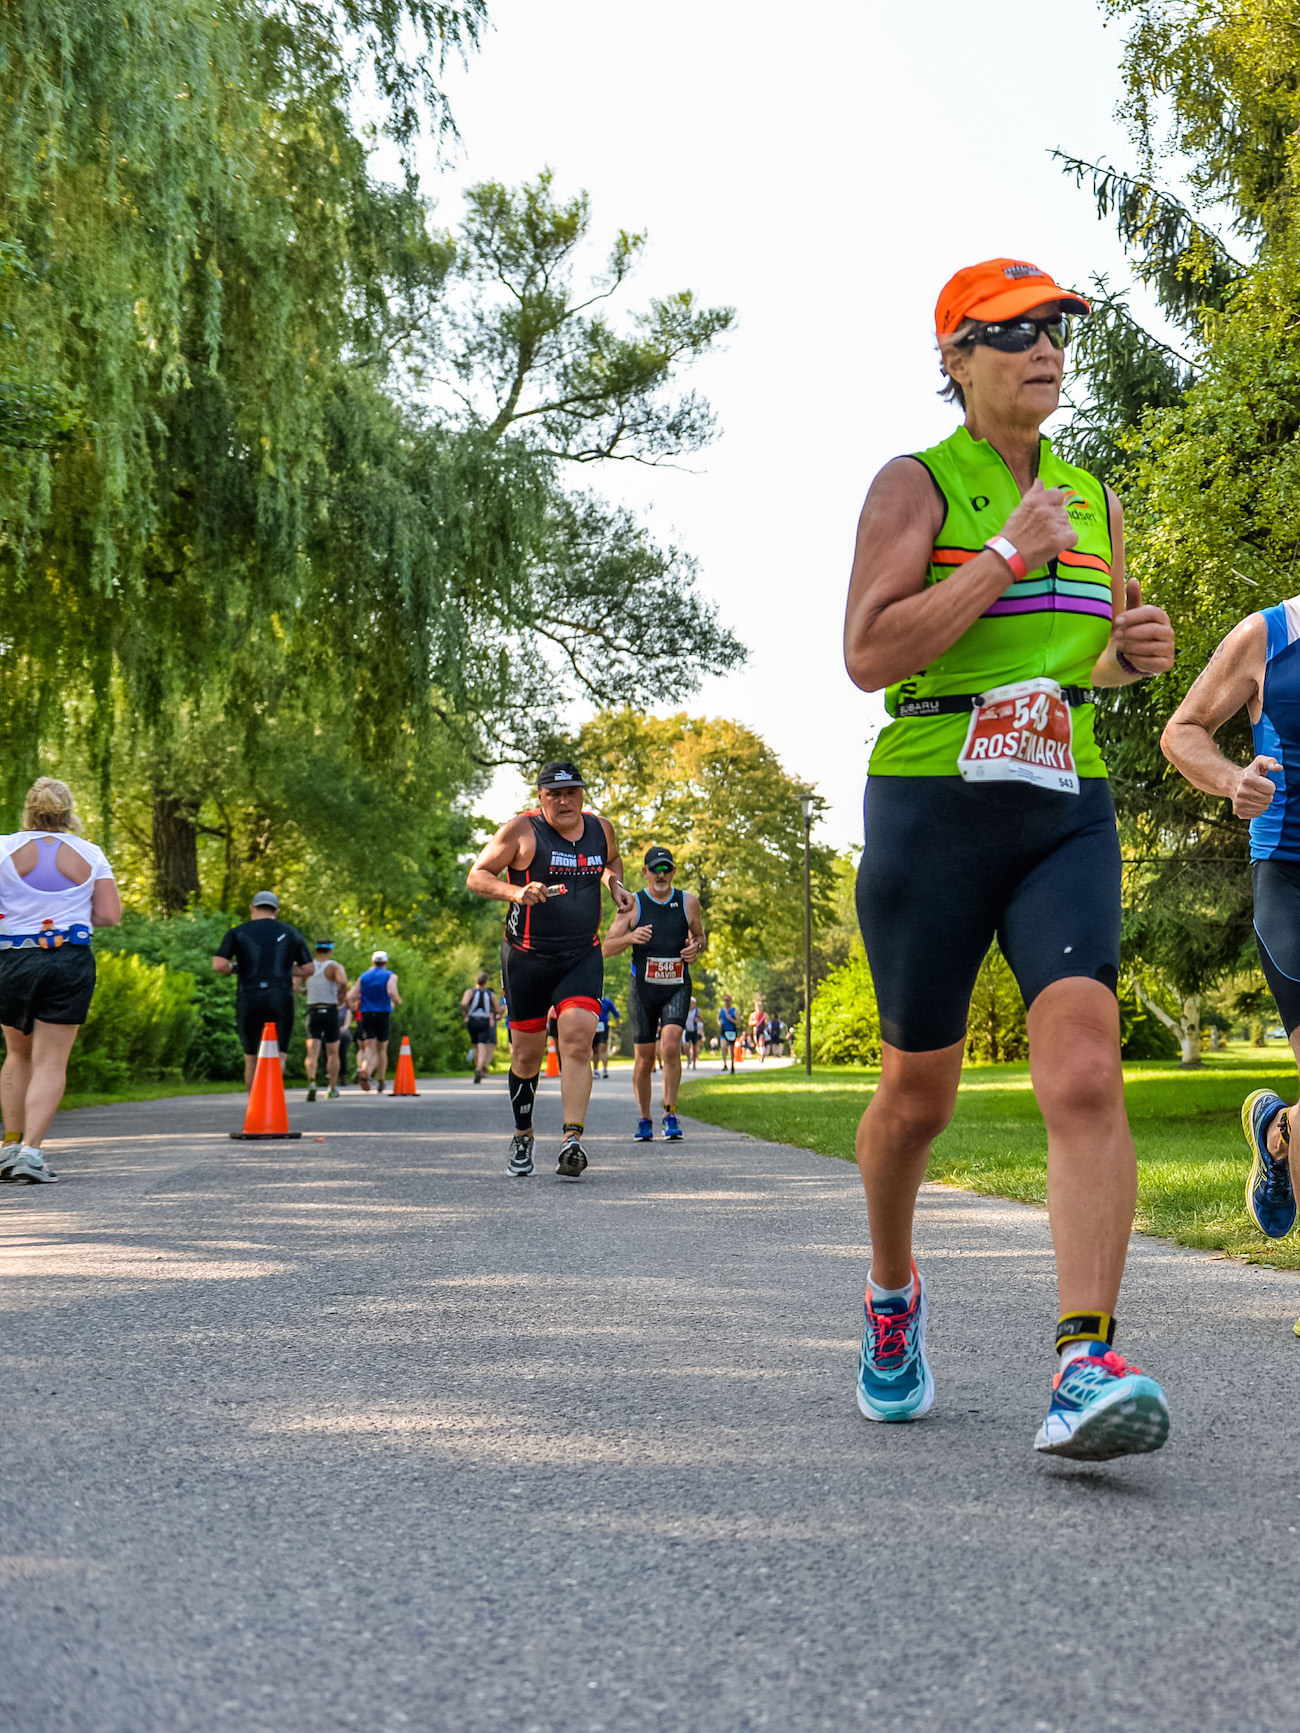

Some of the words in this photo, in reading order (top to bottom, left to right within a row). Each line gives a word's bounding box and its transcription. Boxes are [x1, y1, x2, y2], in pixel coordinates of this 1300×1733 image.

[1058, 777, 1075, 789] 543
[550, 853, 604, 868] IRONMAN
[658, 962, 674, 972] 546
[654, 971, 677, 979] DAVID
